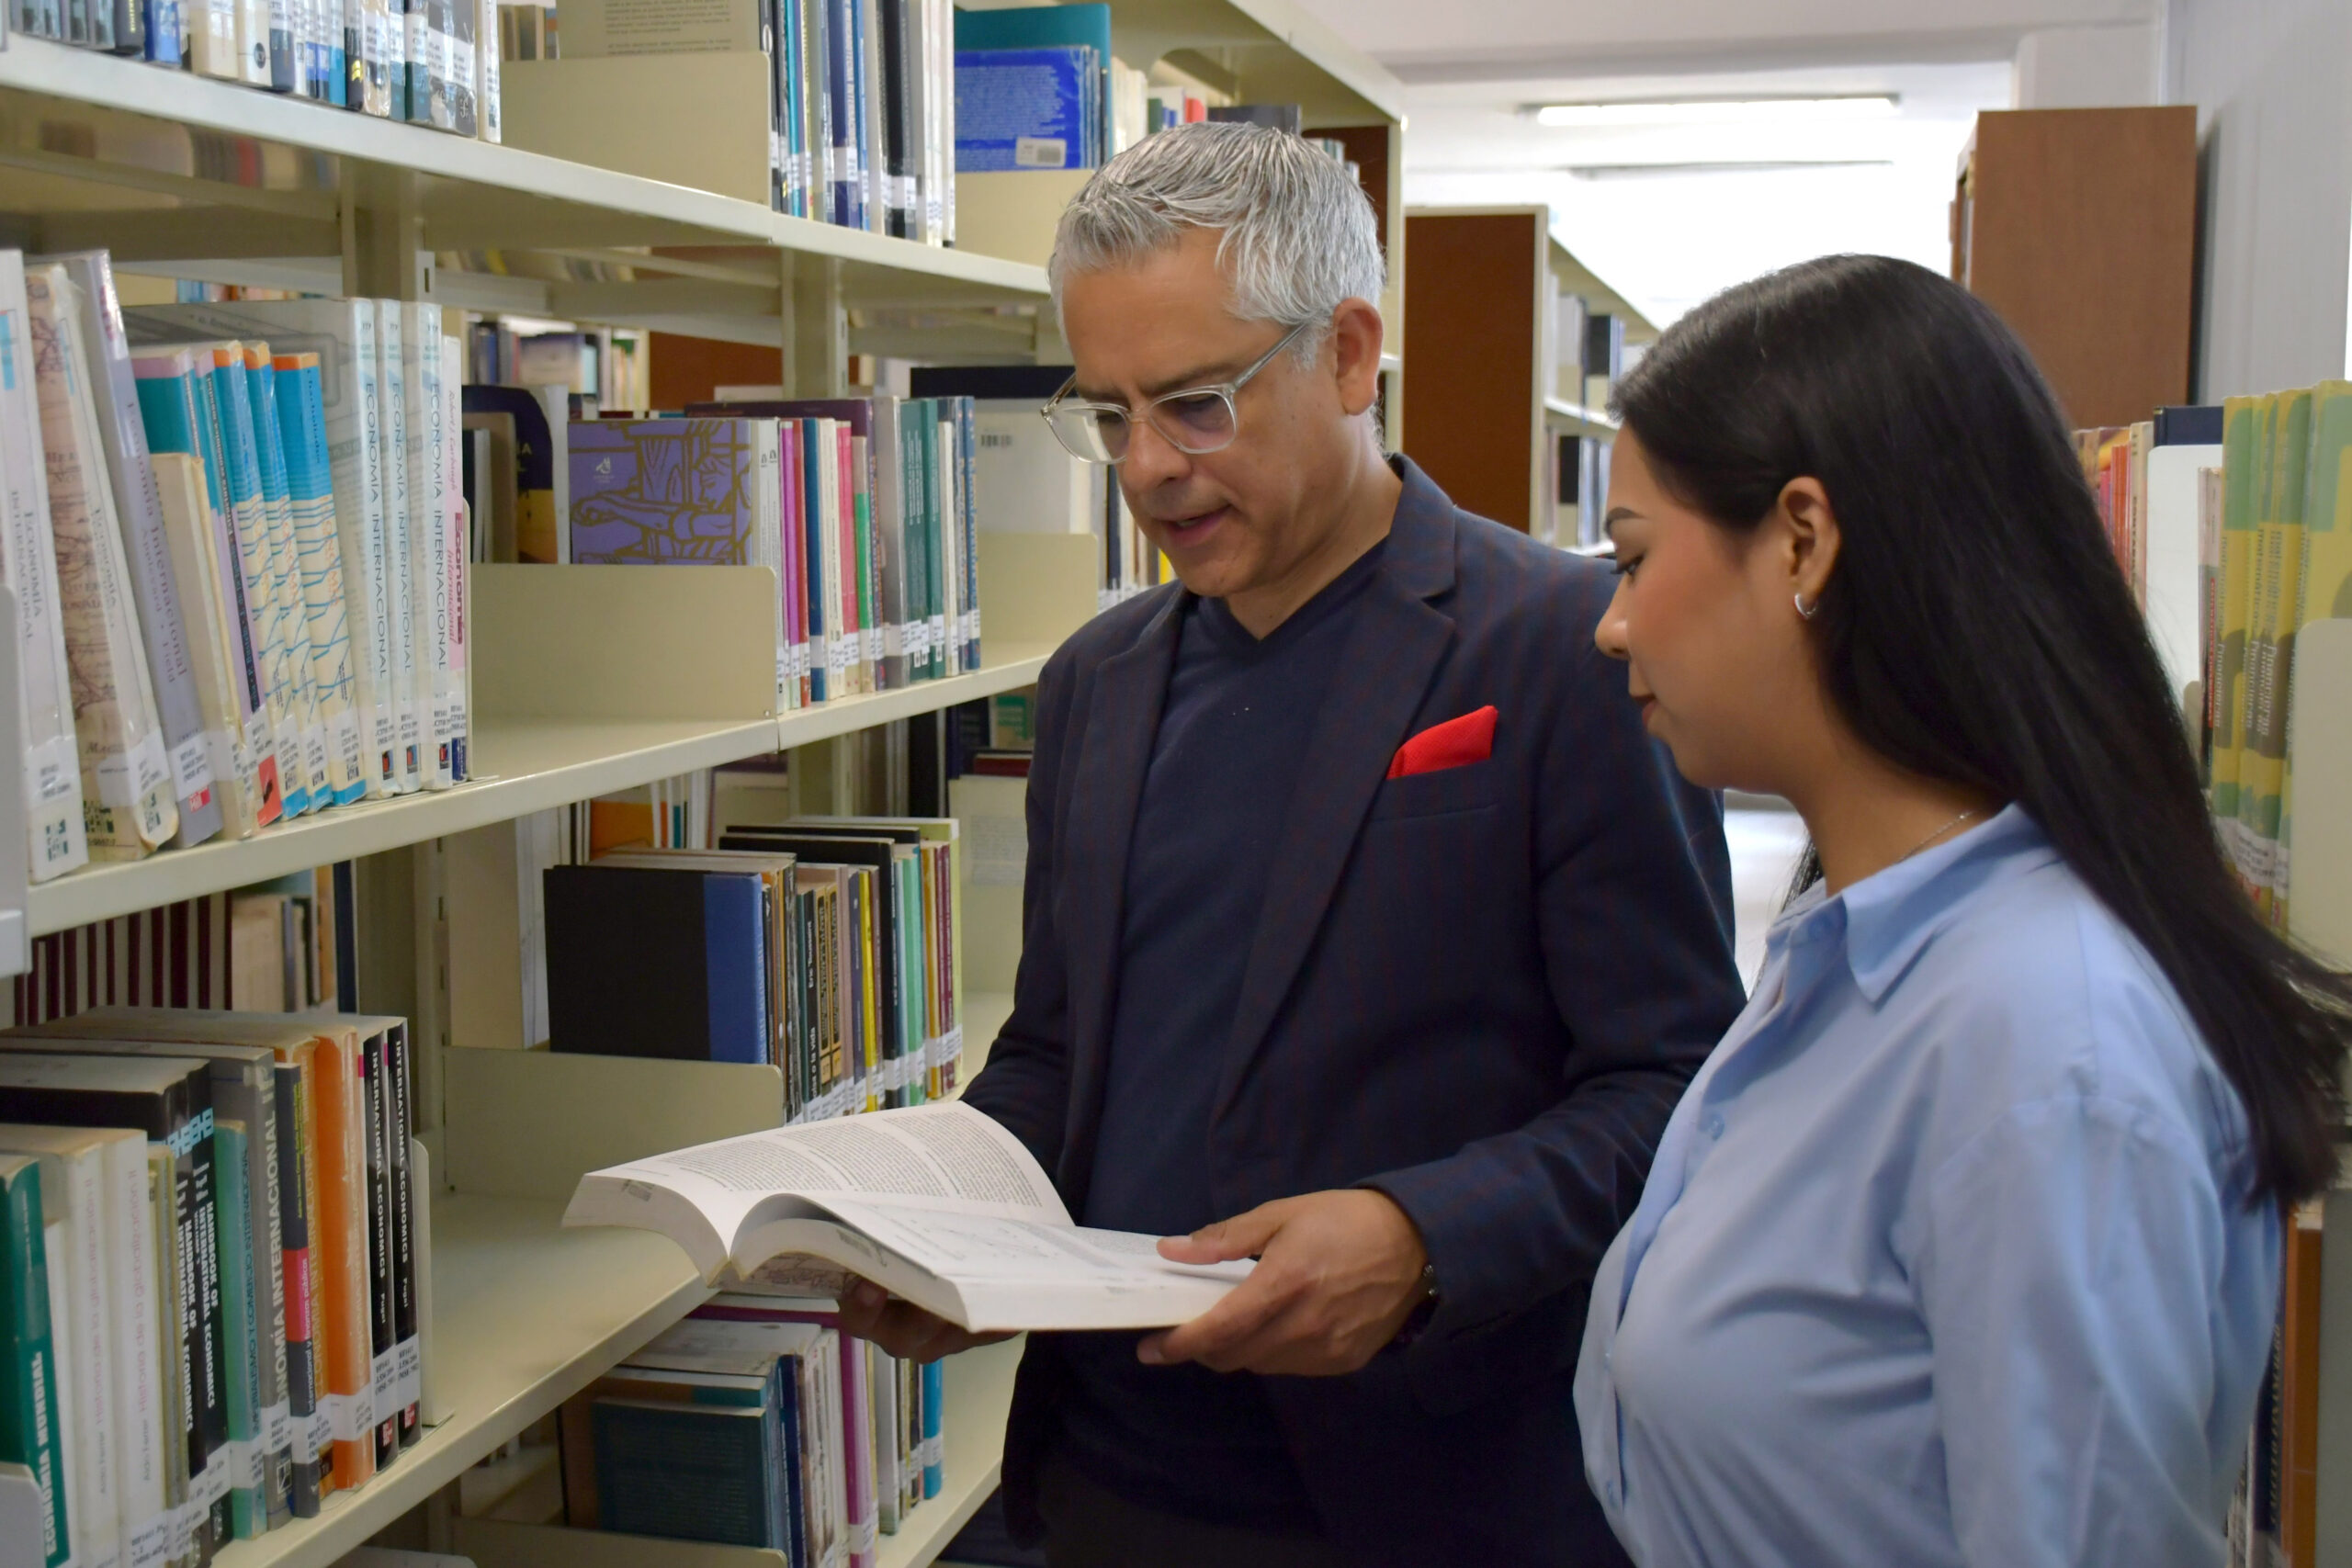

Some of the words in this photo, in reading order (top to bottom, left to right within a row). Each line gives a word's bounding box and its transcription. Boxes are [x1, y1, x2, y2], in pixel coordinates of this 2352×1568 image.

[366, 382, 379, 502] ECONOMÍA
[392, 382, 406, 500] ECONOMÍA
[431, 383, 447, 500] ECONOMÍA
[371, 513, 387, 678] INTERNACIONAL
[397, 511, 412, 673] INTERNACIONAL
[435, 510, 447, 671] INTERNACIONAL
[806, 921, 814, 965] Toussaint
[372, 1051, 383, 1179] INTERNATIONAL
[395, 1040, 406, 1167] INTERNATIONAL
[84, 1192, 101, 1309] globalización
[128, 1179, 146, 1296] globalización
[185, 1220, 198, 1305] HANDBOOK
[198, 1207, 214, 1320] INTERNATIONAL
[207, 1201, 218, 1284] HANDBOOK
[263, 1111, 285, 1308] INTERNACIONAL
[377, 1184, 386, 1278] ECONOMICS
[400, 1170, 408, 1263] ECONOMICS
[209, 1289, 219, 1308] OF
[30, 1351, 50, 1447] MUNDIAL
[92, 1361, 105, 1425] Historia
[135, 1350, 148, 1413] Historia
[183, 1346, 195, 1431] ECONOMICS
[203, 1325, 216, 1408] ECONOMICS
[38, 1449, 58, 1557] ECONOMÍA
